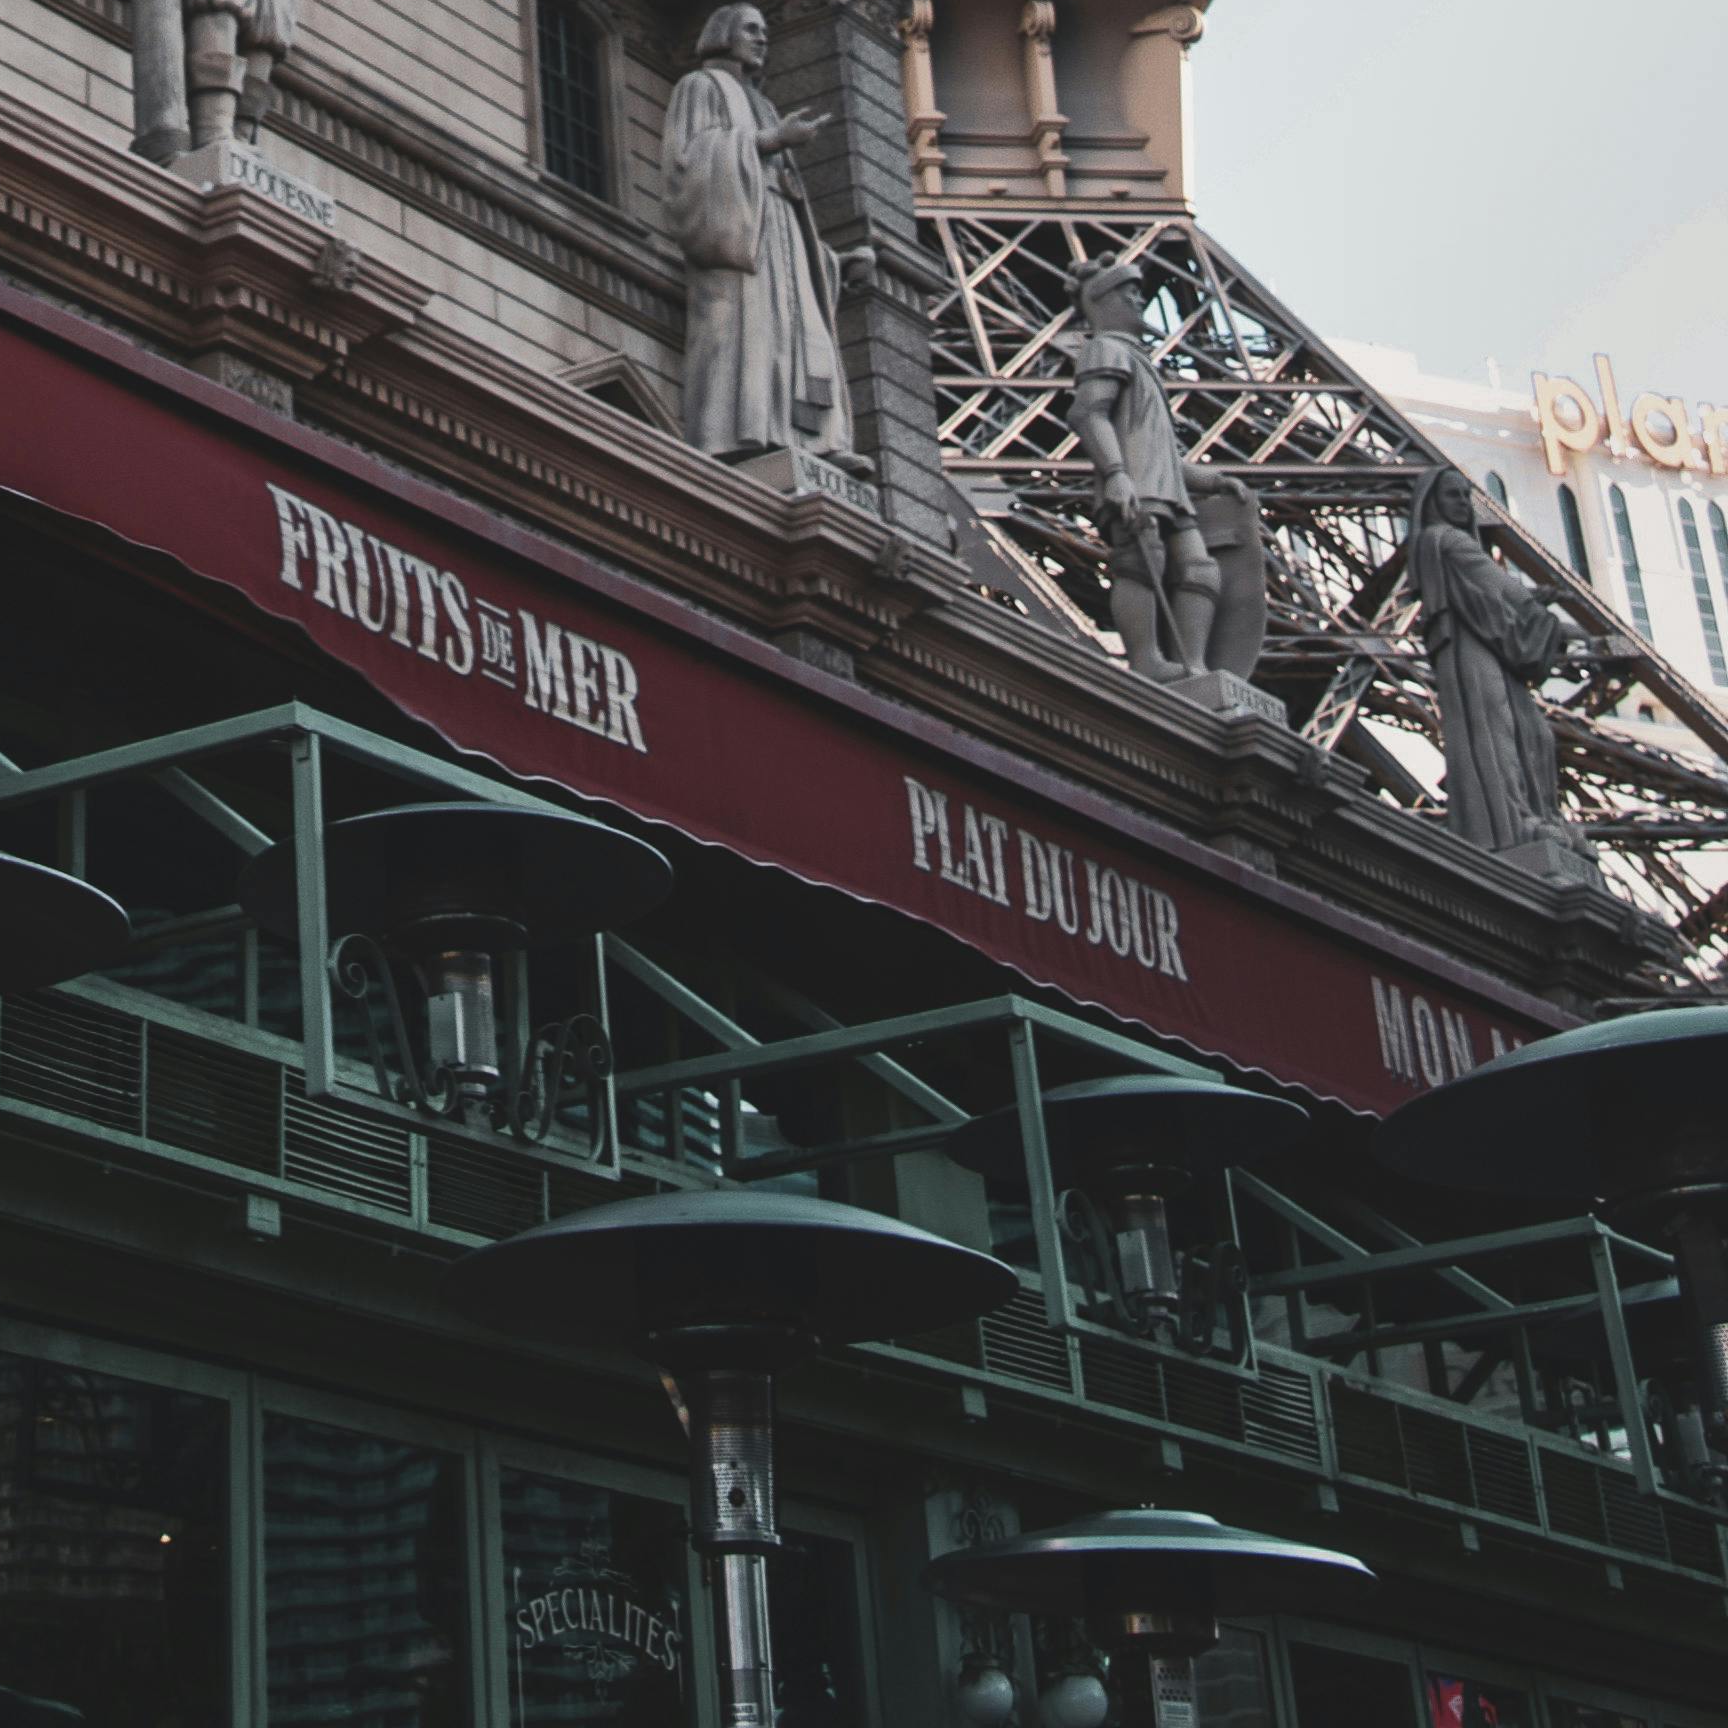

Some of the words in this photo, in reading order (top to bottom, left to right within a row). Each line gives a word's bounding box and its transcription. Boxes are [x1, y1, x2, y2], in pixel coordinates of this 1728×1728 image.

[266, 482, 474, 678] FRUITS
[479, 613, 516, 674] DE
[518, 608, 648, 754] MER
[903, 775, 1011, 907] PLAT
[1016, 830, 1079, 937] DU
[1083, 857, 1188, 982] JOUR
[1370, 975, 1473, 1088] MON
